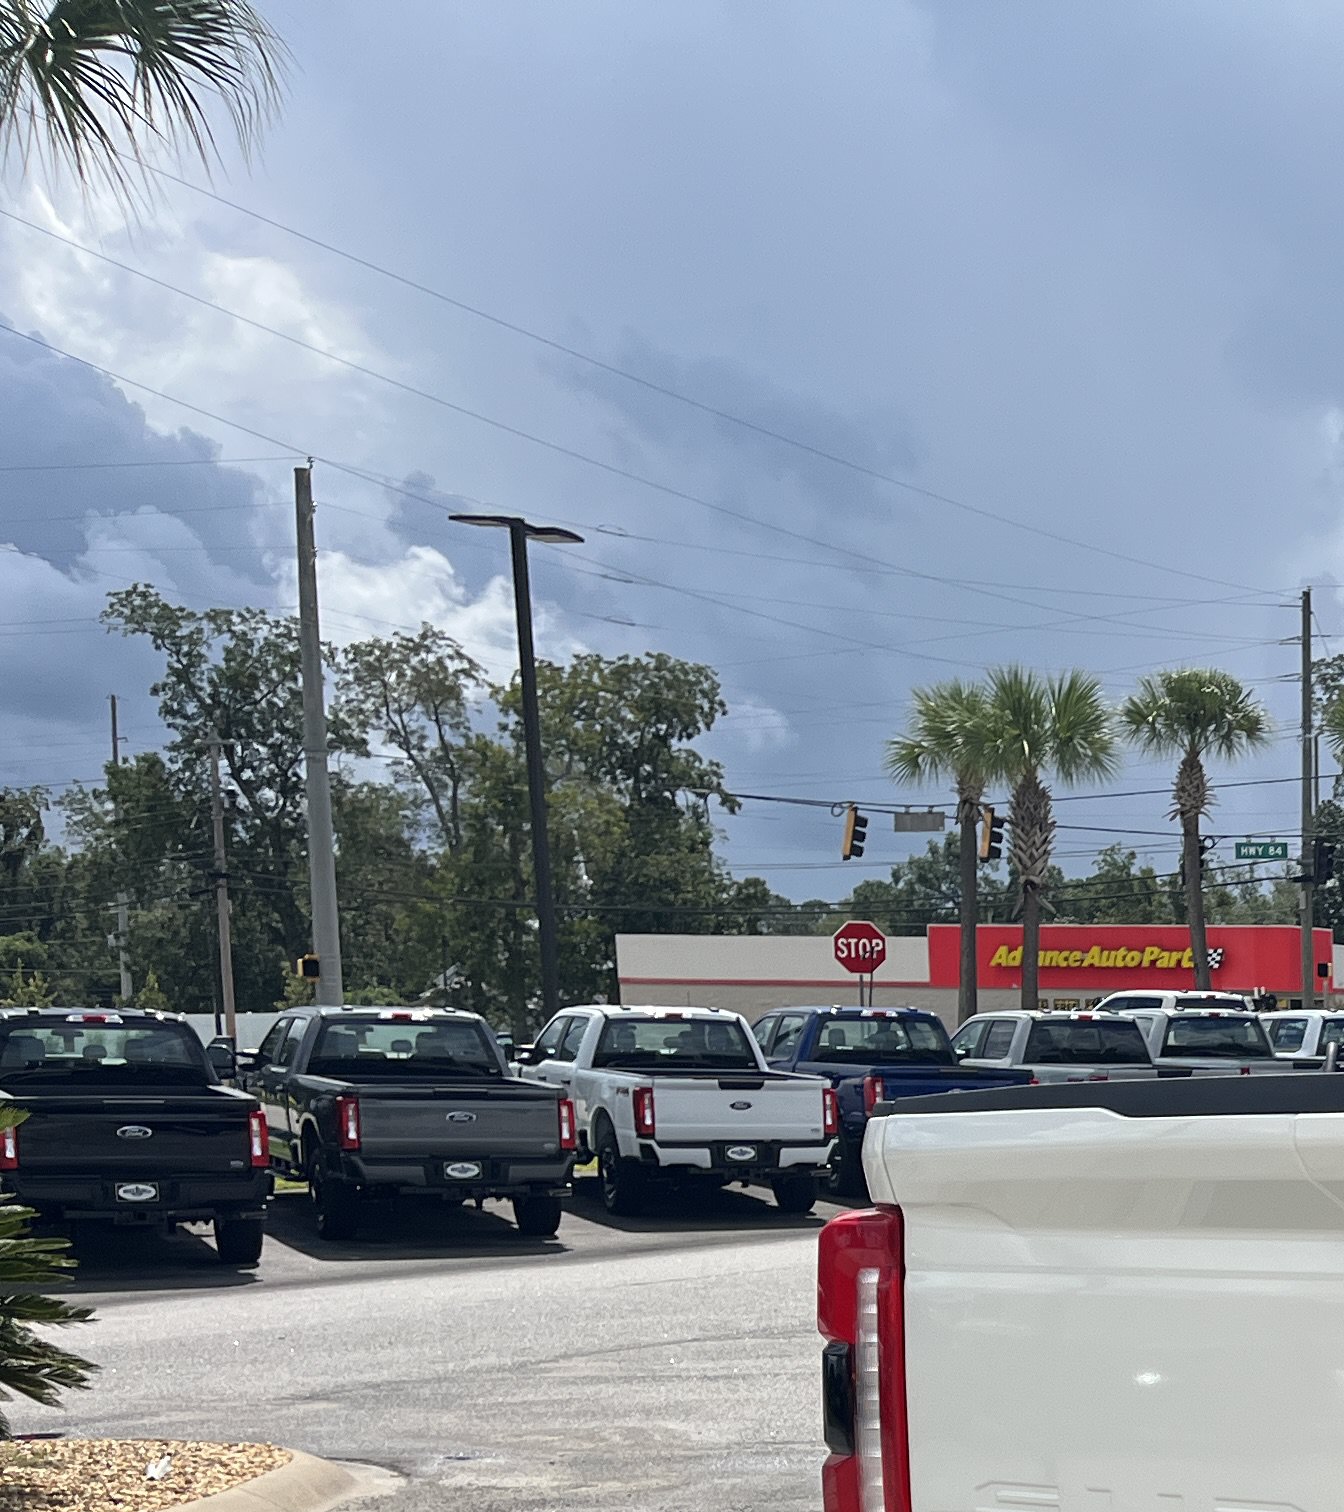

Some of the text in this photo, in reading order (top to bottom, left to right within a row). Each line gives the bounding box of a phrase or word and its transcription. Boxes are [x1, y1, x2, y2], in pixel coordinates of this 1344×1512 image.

[1240, 845, 1283, 856] HWY 84
[837, 937, 883, 960] STOP
[989, 945, 1196, 968] Adnce Auto Part
